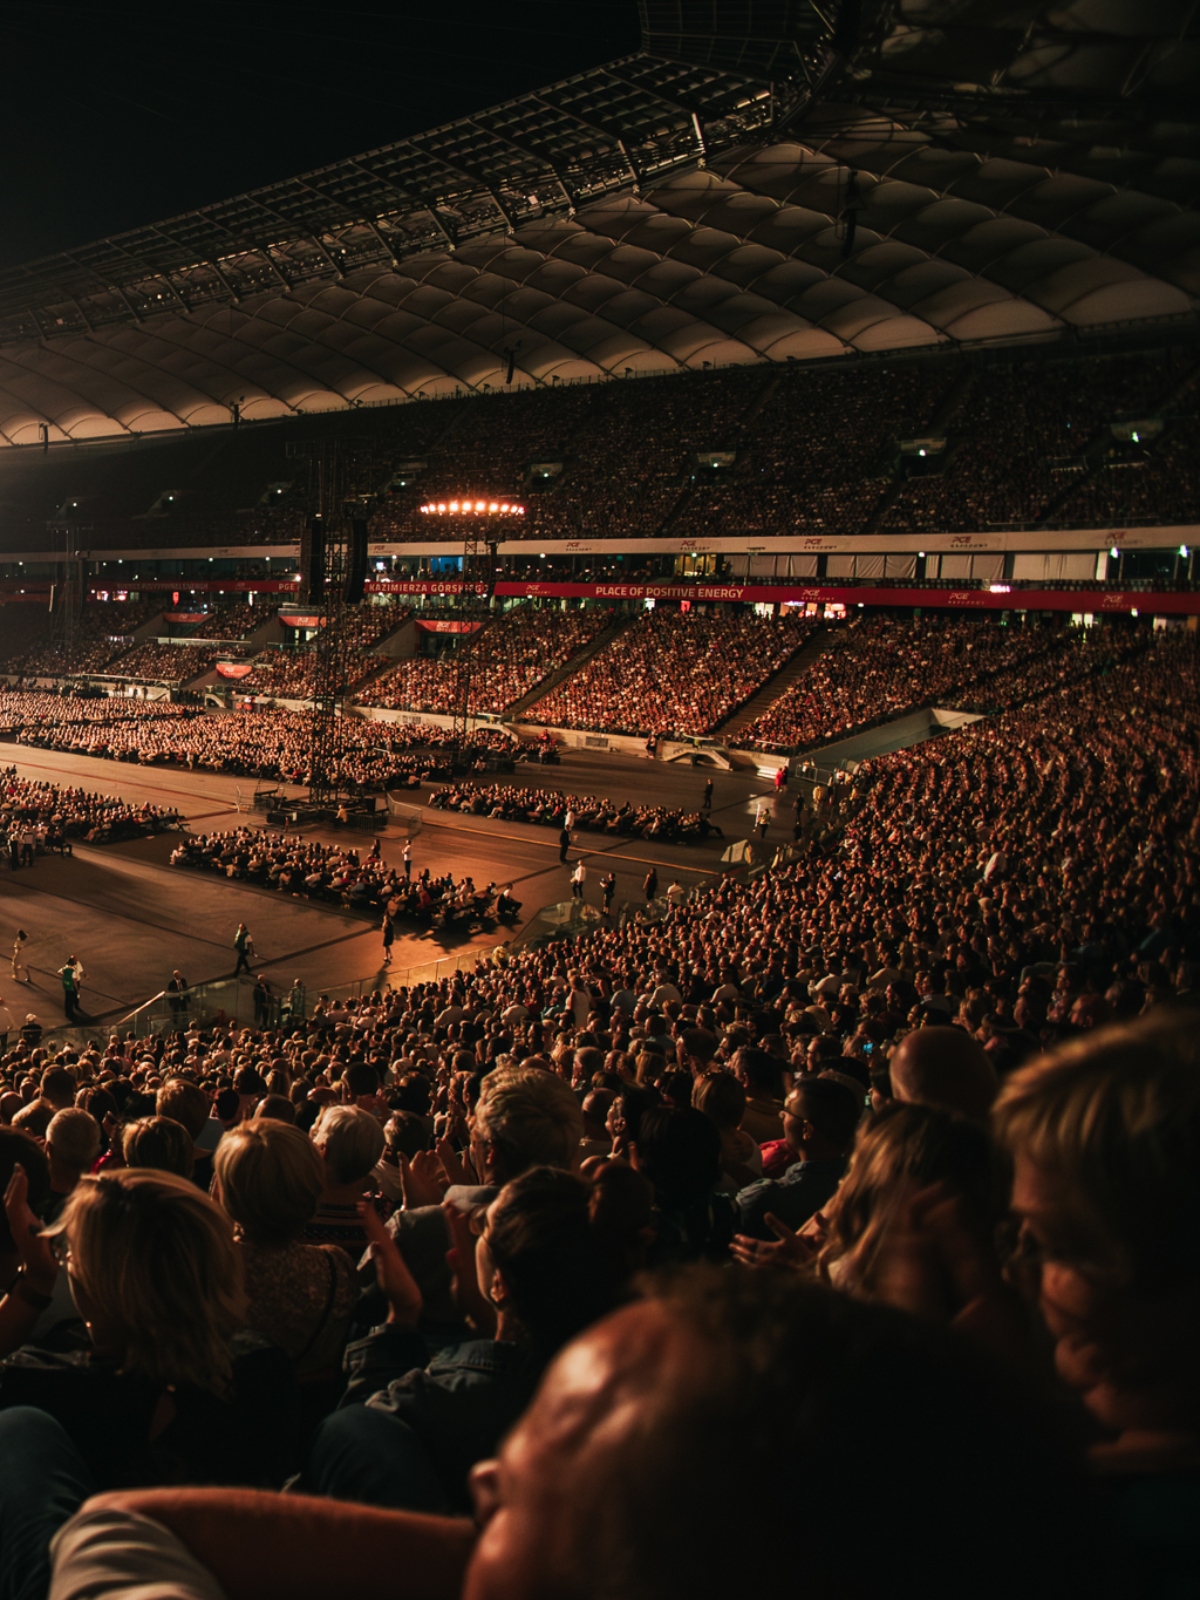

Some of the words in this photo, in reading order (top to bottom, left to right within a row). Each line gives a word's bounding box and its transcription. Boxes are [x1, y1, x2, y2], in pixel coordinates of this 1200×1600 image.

[369, 583, 428, 592] KAZIMIERZA
[596, 586, 627, 596] PLACE
[629, 587, 644, 596] OF
[646, 587, 695, 598] POSITIVE
[698, 588, 744, 598] ENERGY
[948, 592, 969, 600] PGE
